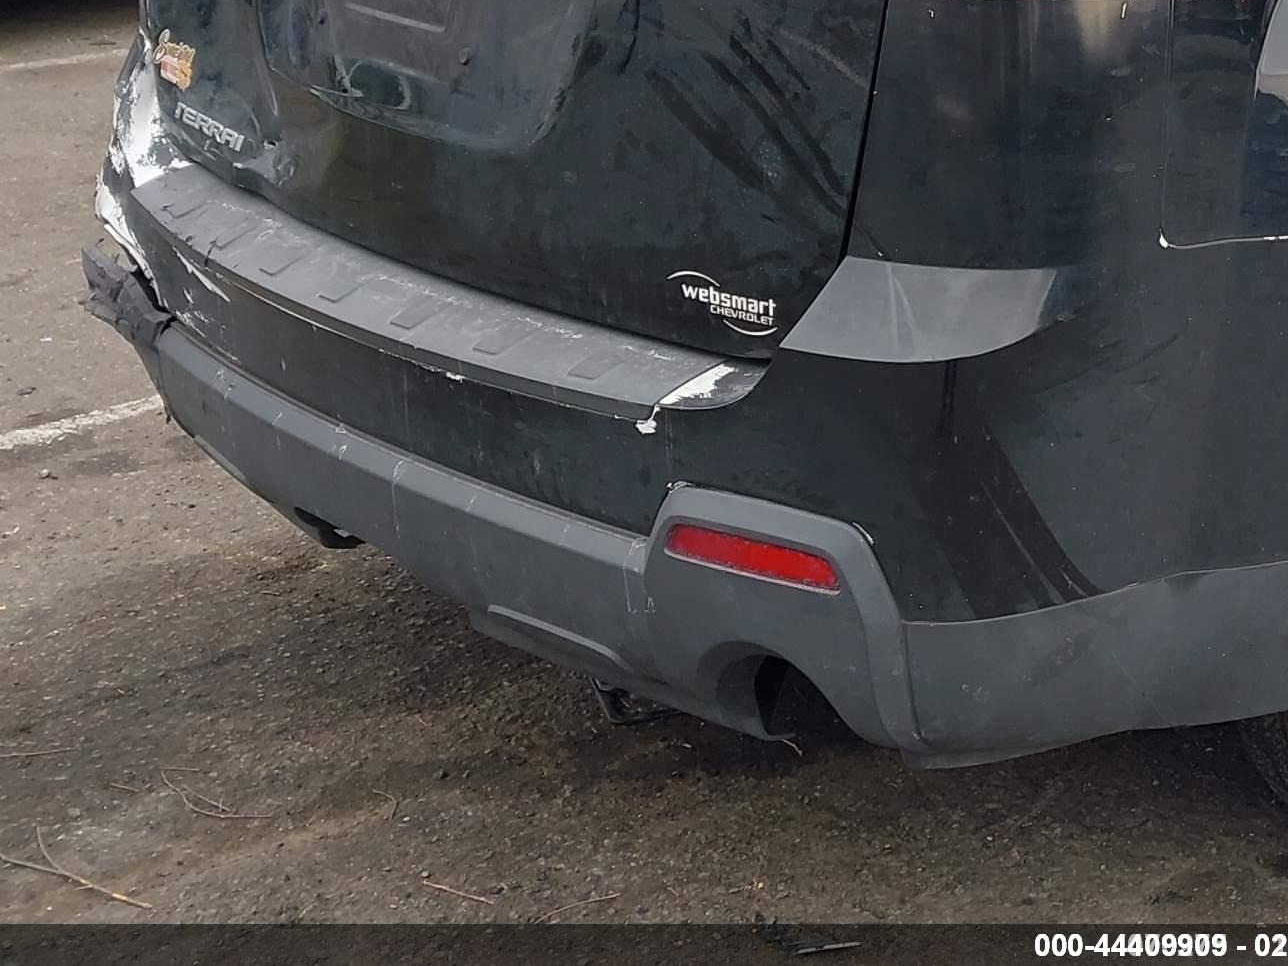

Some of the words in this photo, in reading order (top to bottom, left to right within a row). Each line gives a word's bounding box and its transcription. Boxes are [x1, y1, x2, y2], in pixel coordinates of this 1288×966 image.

[174, 101, 245, 152] TERRAI
[681, 283, 776, 317] websmart
[710, 304, 774, 327] CHEVROLET
